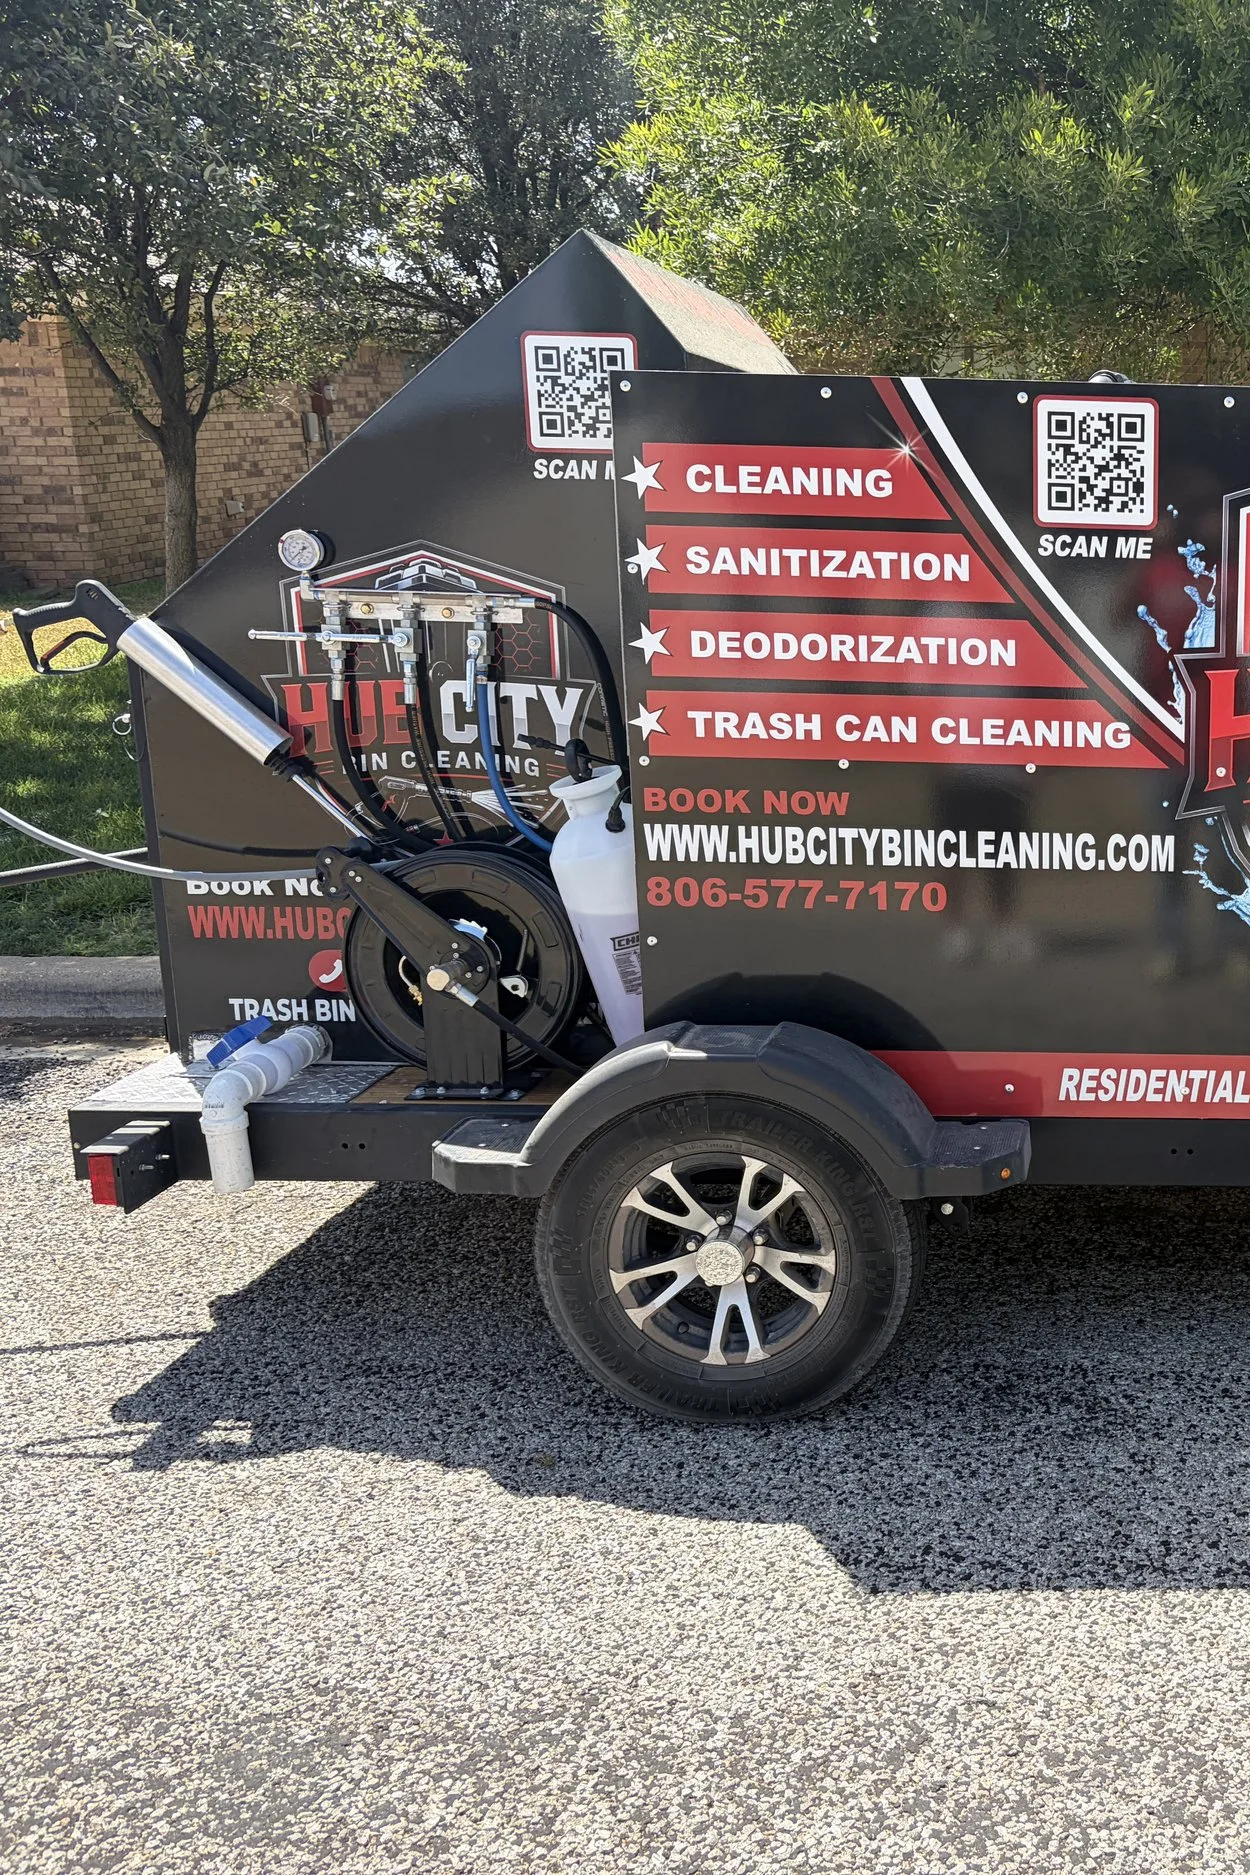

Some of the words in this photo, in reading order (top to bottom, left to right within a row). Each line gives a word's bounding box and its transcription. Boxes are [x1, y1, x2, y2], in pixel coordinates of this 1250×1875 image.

[533, 458, 597, 480] SCAN
[685, 464, 894, 498] CLEANING
[685, 546, 971, 582] SANITIZATION
[1038, 534, 1107, 559] SCAN
[1115, 536, 1153, 560] ME
[690, 631, 1017, 667] DEODORIZATION
[687, 710, 822, 742] TRASH
[836, 713, 918, 745] CAN
[931, 717, 1132, 750] CLEANING
[342, 752, 388, 775] IN
[401, 750, 540, 777] CEANING
[643, 787, 751, 815] BOOK
[764, 791, 850, 817] NOW
[644, 823, 1176, 873] WWW.HUBCITYBINCLEANING.COM
[186, 879, 274, 896] BOOK
[647, 877, 948, 912] 806-577-7170
[228, 998, 308, 1021] TRASH
[315, 999, 356, 1022] BIN
[1058, 1067, 1250, 1103] RESIDENTIAL
